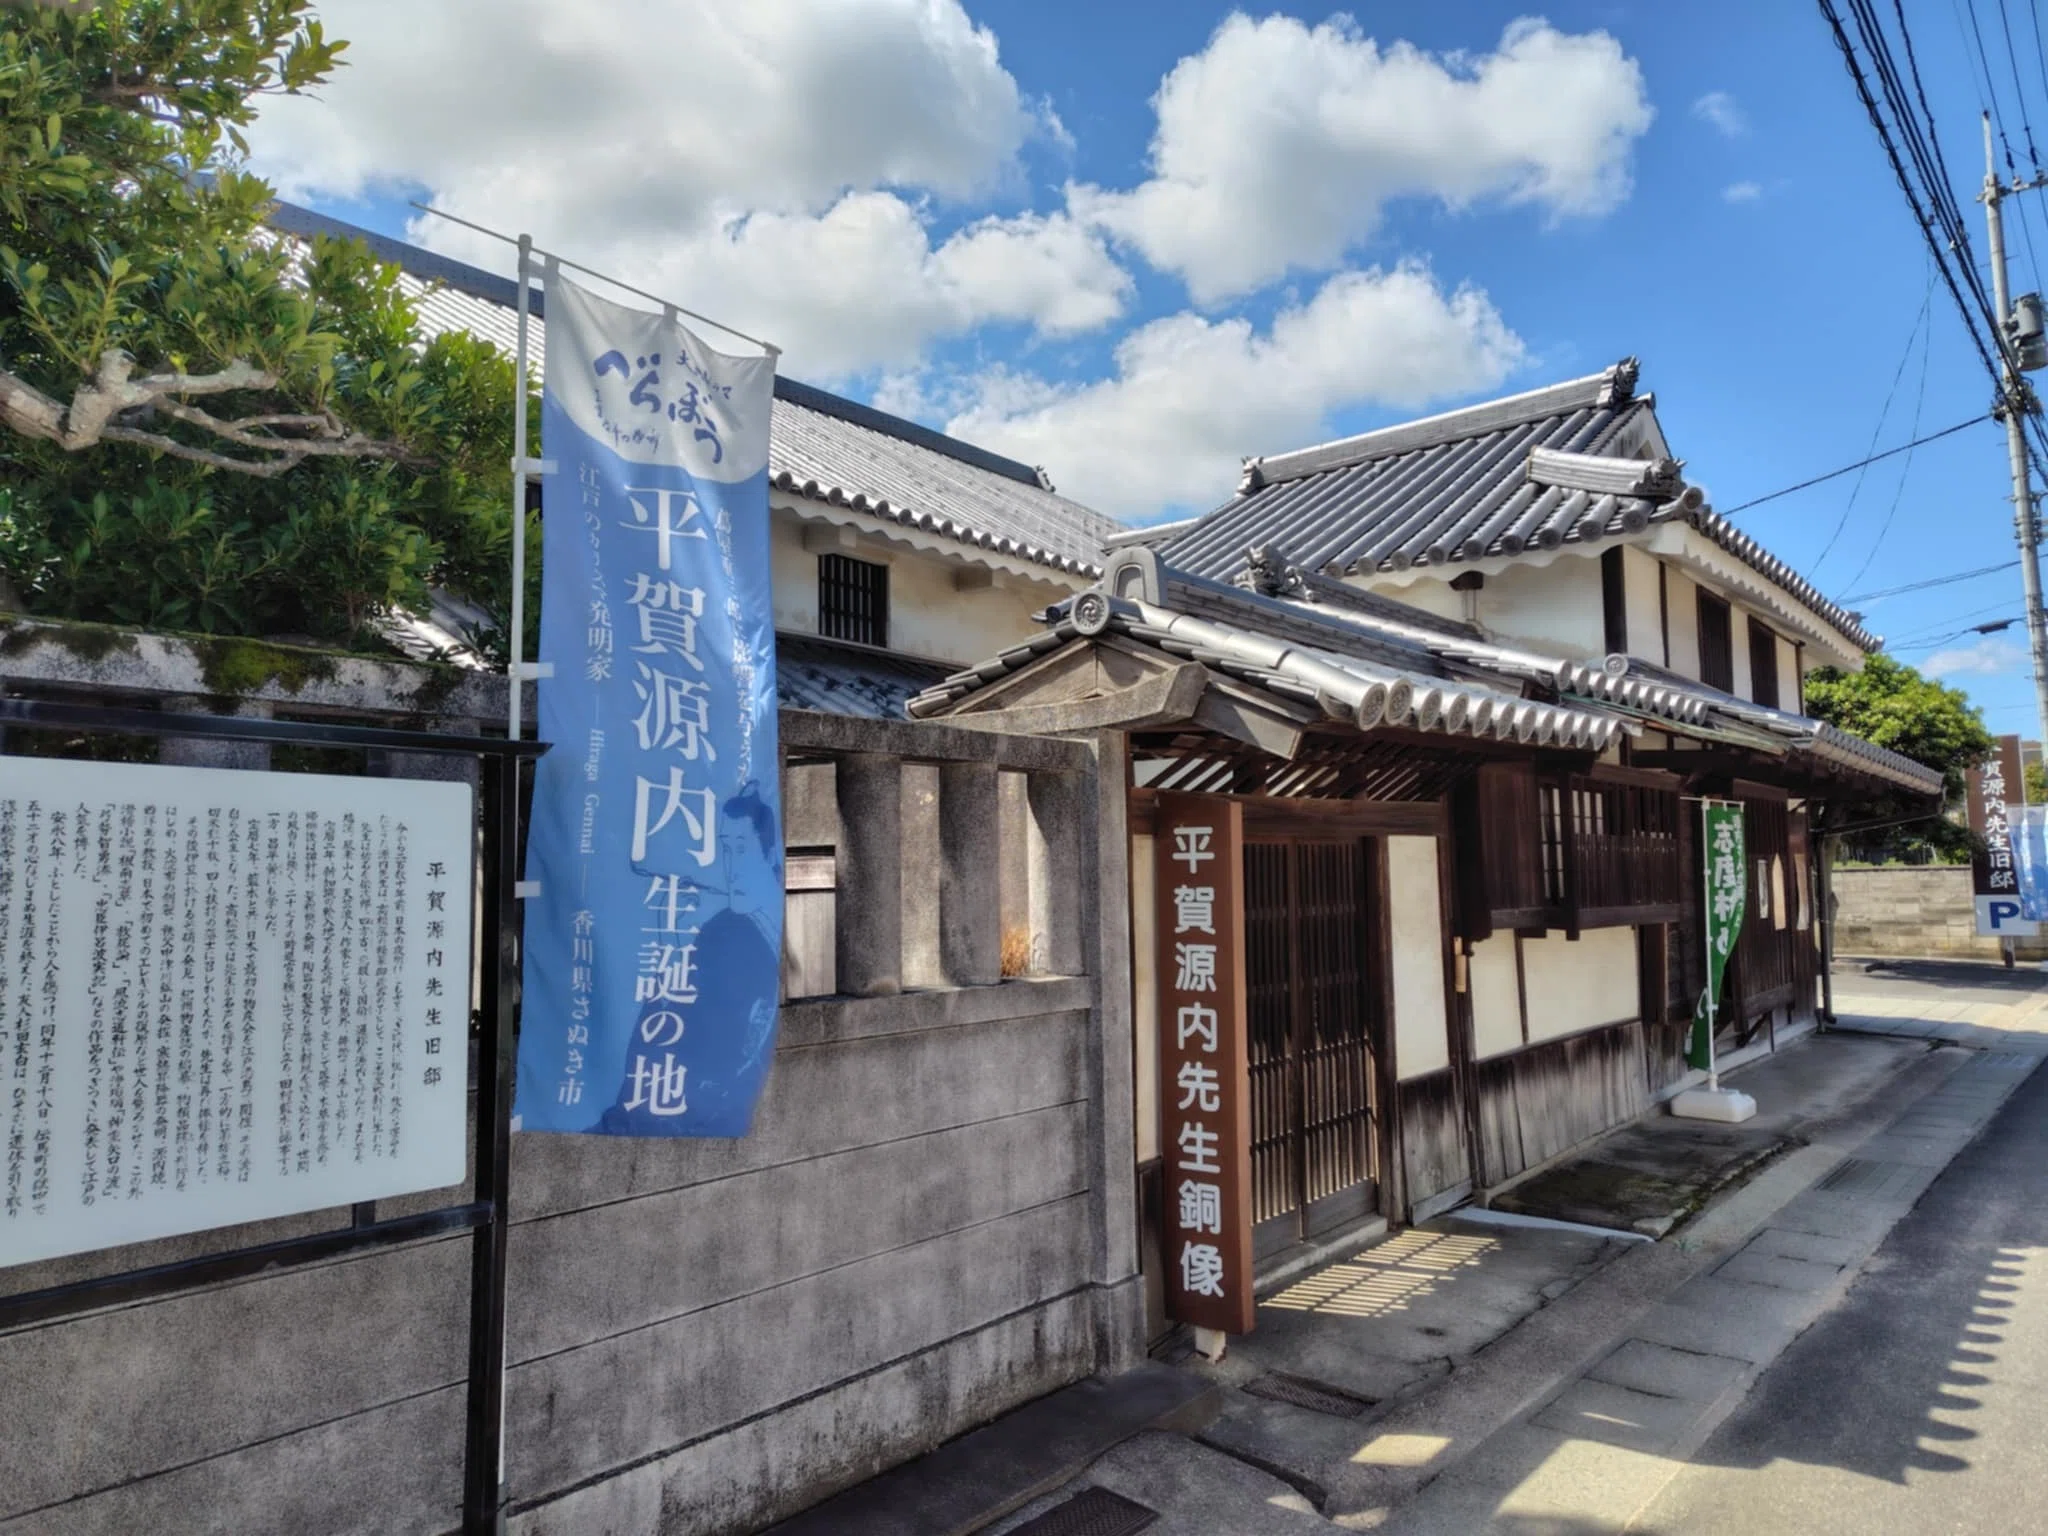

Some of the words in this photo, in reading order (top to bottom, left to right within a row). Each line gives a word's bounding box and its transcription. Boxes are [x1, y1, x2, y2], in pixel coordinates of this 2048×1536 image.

[594, 350, 722, 464] べらぼう
[580, 794, 600, 855] Gennai
[584, 728, 605, 782] Hiraga
[618, 484, 718, 1116] 平賀源内生誕の地
[424, 862, 445, 1086] 平賀源内先生旧邸
[1989, 901, 2021, 929] P
[558, 910, 597, 1105] 香川県さぬき市
[1172, 825, 1225, 1298] 平賀源内先生銅像
